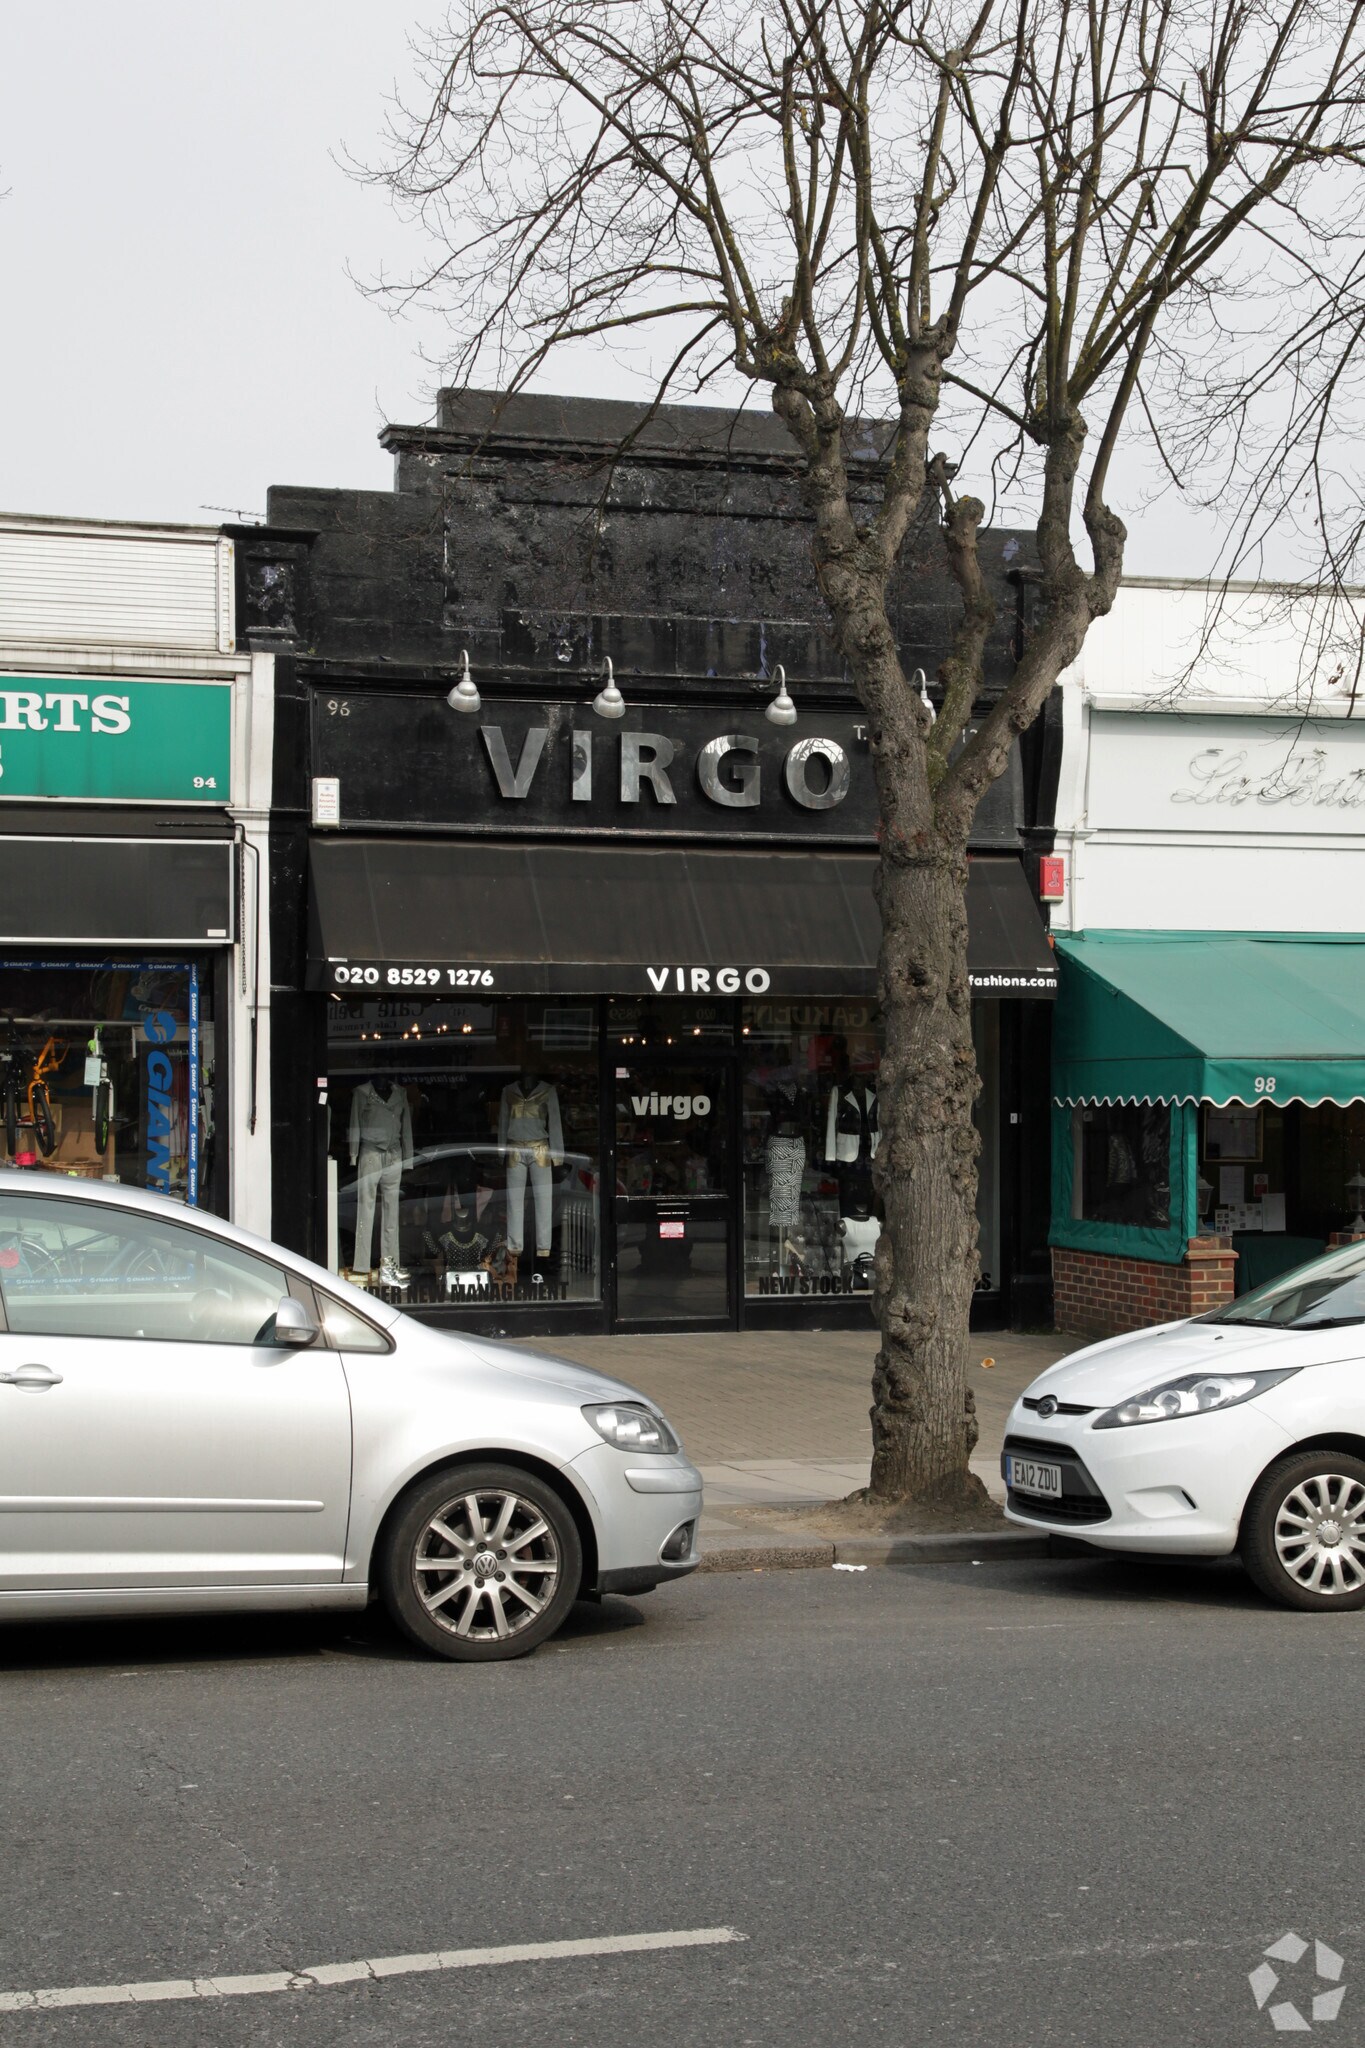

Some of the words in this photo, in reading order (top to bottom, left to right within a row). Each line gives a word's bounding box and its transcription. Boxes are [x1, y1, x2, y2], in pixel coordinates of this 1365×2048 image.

[328, 699, 351, 717] 96
[480, 725, 851, 810] VIRGO
[192, 776, 217, 789] 94
[334, 966, 379, 985] 020
[387, 967, 441, 986] 8529
[447, 968, 494, 986] 1276
[646, 967, 771, 993] VIRGO
[1254, 1077, 1276, 1093] 98
[631, 1091, 711, 1120] virgo
[147, 1050, 173, 1195] GIANT
[407, 1284, 446, 1304] NEW
[451, 1281, 570, 1303] MANAGEMENT
[758, 1276, 796, 1295] NEW
[799, 1276, 854, 1294] STOCK
[1014, 1461, 1035, 1487] EA12
[1037, 1466, 1058, 1492] ZDU
